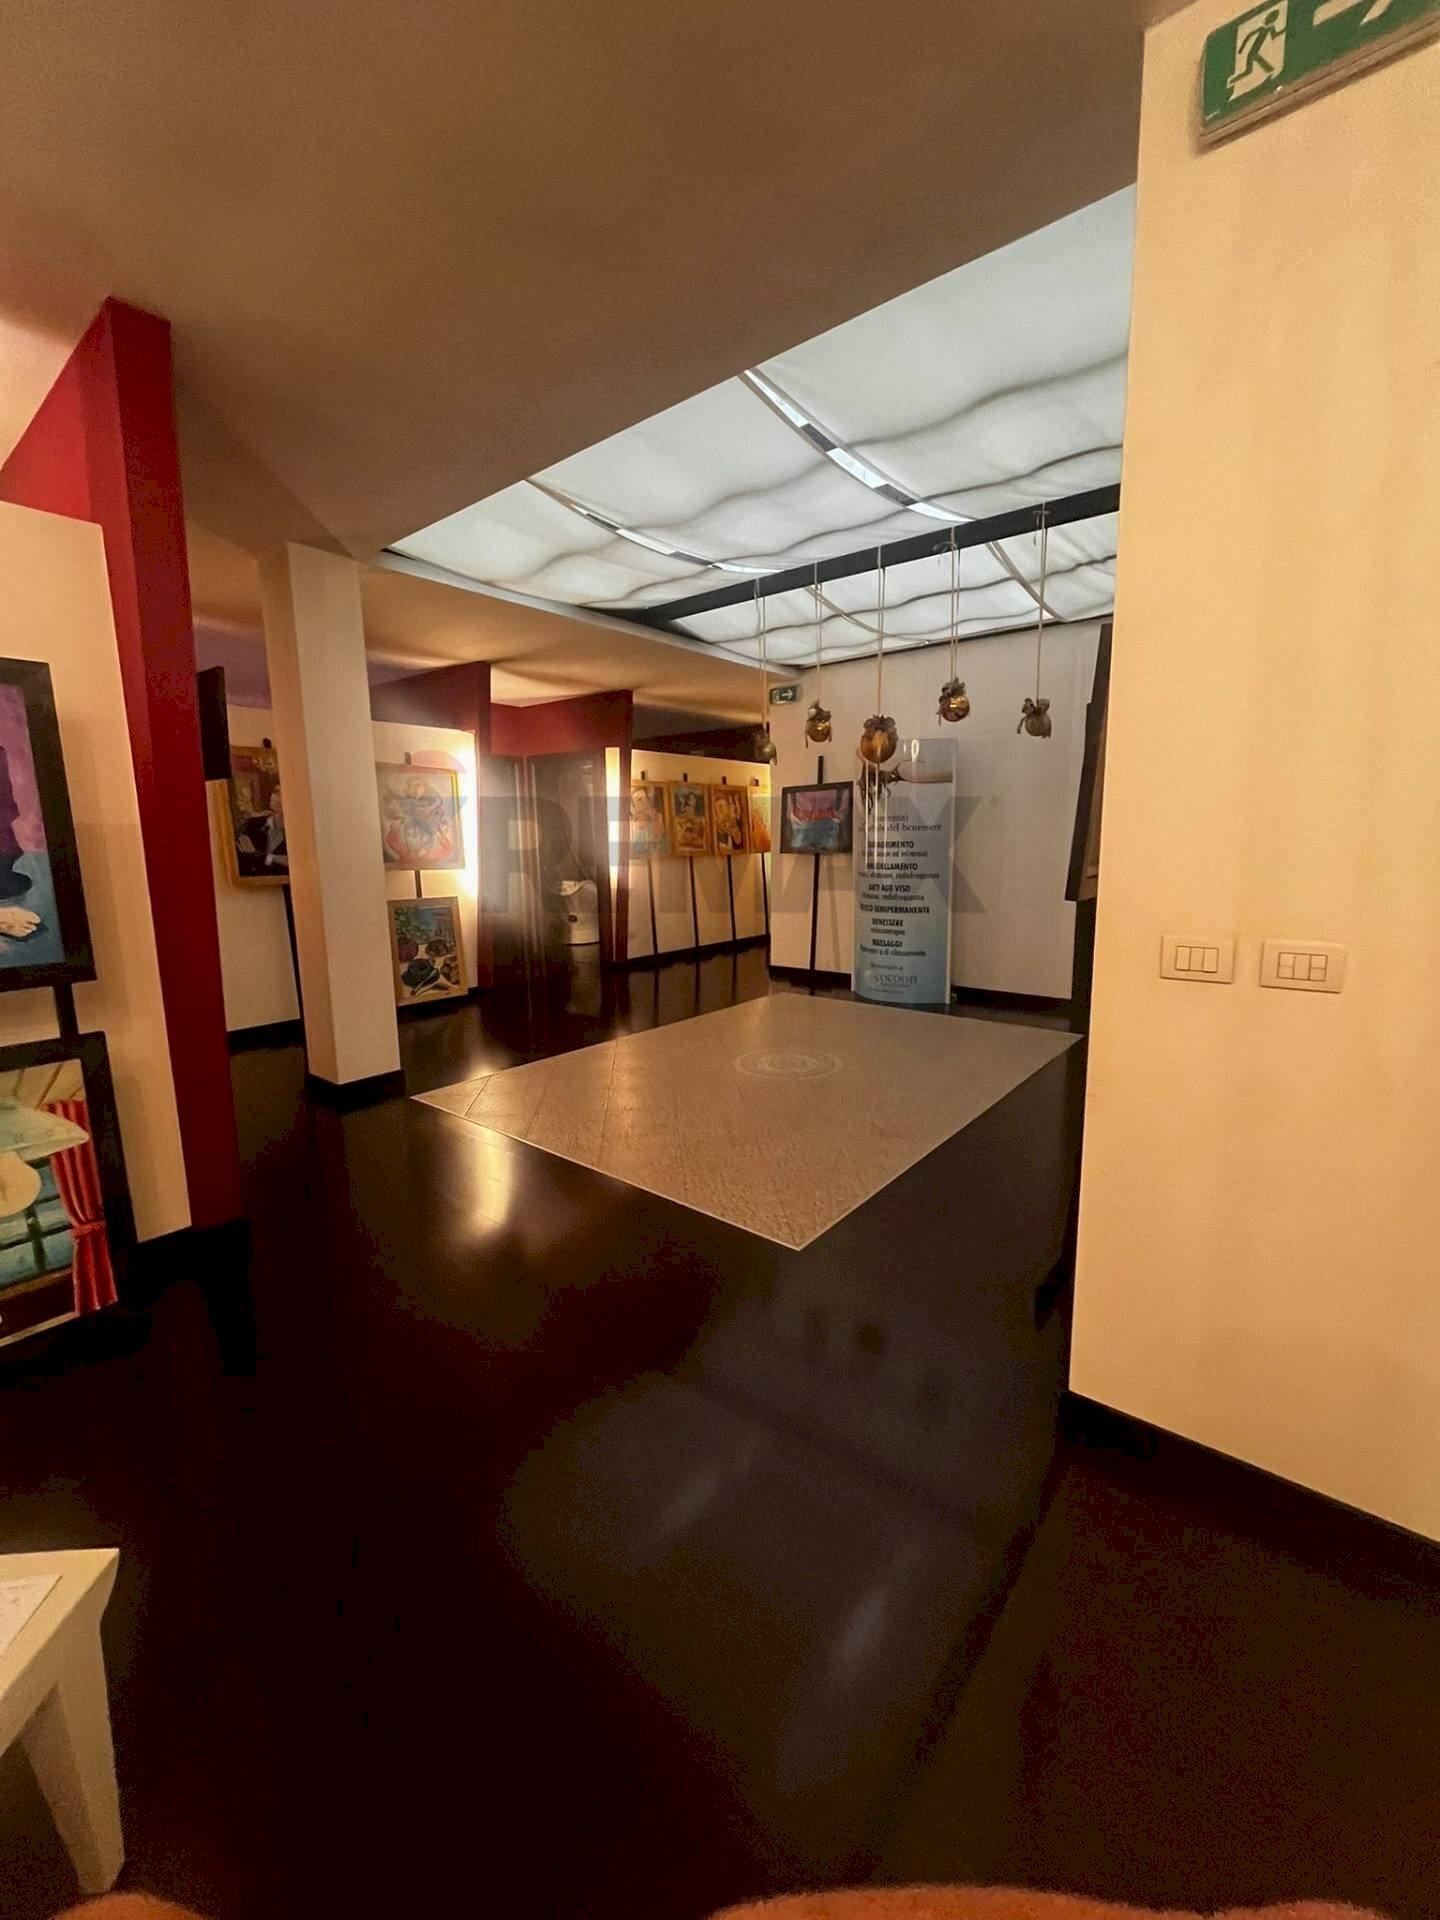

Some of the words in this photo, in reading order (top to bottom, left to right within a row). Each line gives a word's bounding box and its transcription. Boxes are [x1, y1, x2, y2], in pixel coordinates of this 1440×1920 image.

[902, 823, 943, 832] benessere
[881, 884, 893, 892] AGE
[894, 884, 911, 892] VISO
[872, 918, 903, 927] BENESSERE
[872, 939, 903, 948] MASSAGGI
